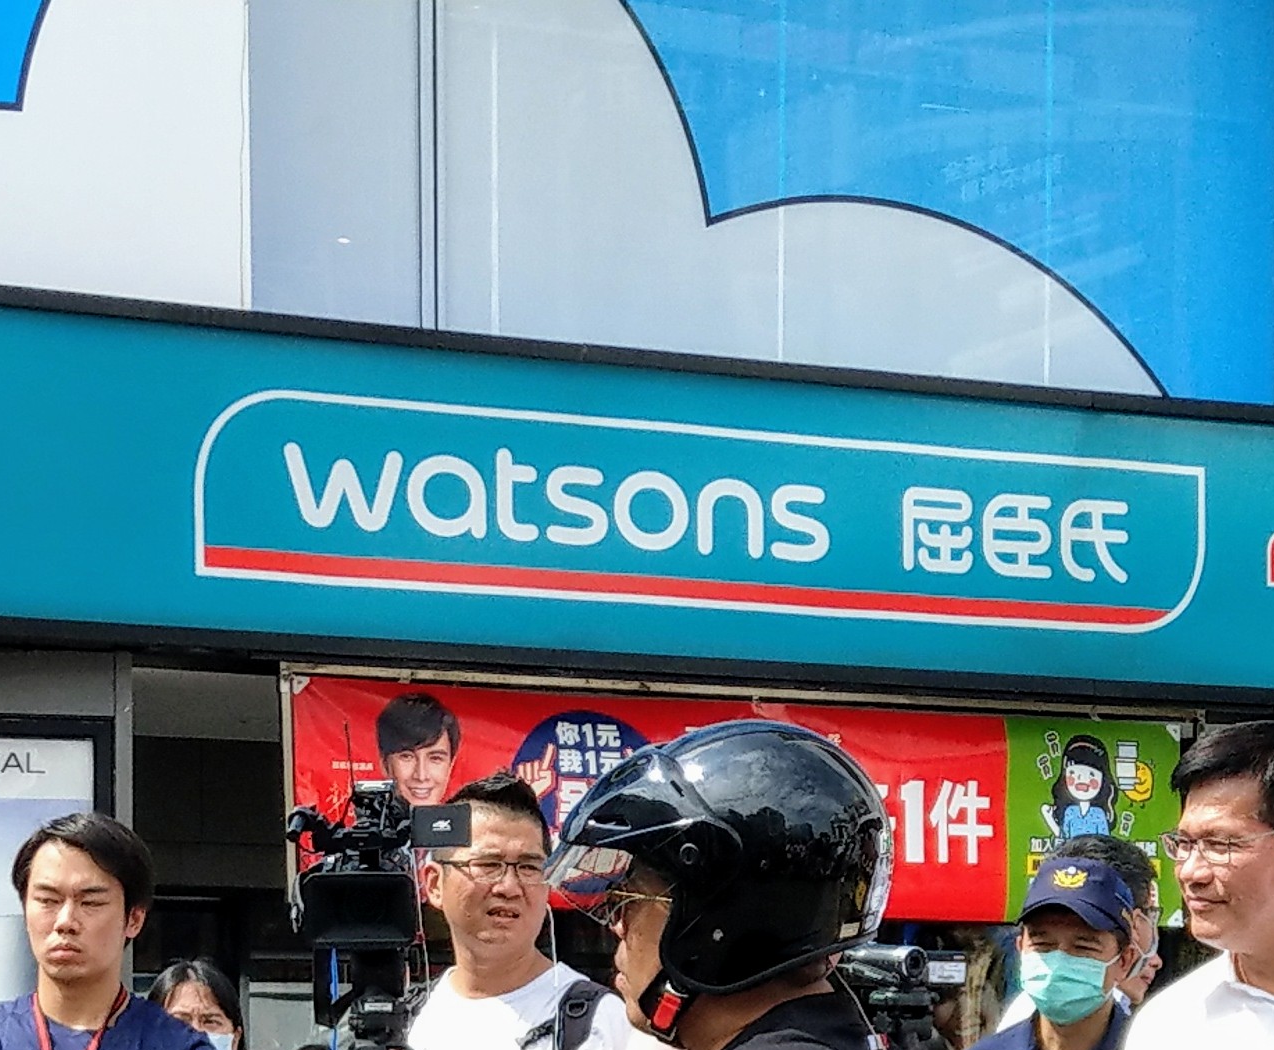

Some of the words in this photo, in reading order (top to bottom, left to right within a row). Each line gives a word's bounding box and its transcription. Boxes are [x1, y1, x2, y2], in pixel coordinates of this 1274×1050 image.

[283, 442, 831, 565] watsons
[902, 485, 1128, 585] 屈臣氏
[556, 721, 621, 747] 你1元
[875, 779, 994, 864] 1件
